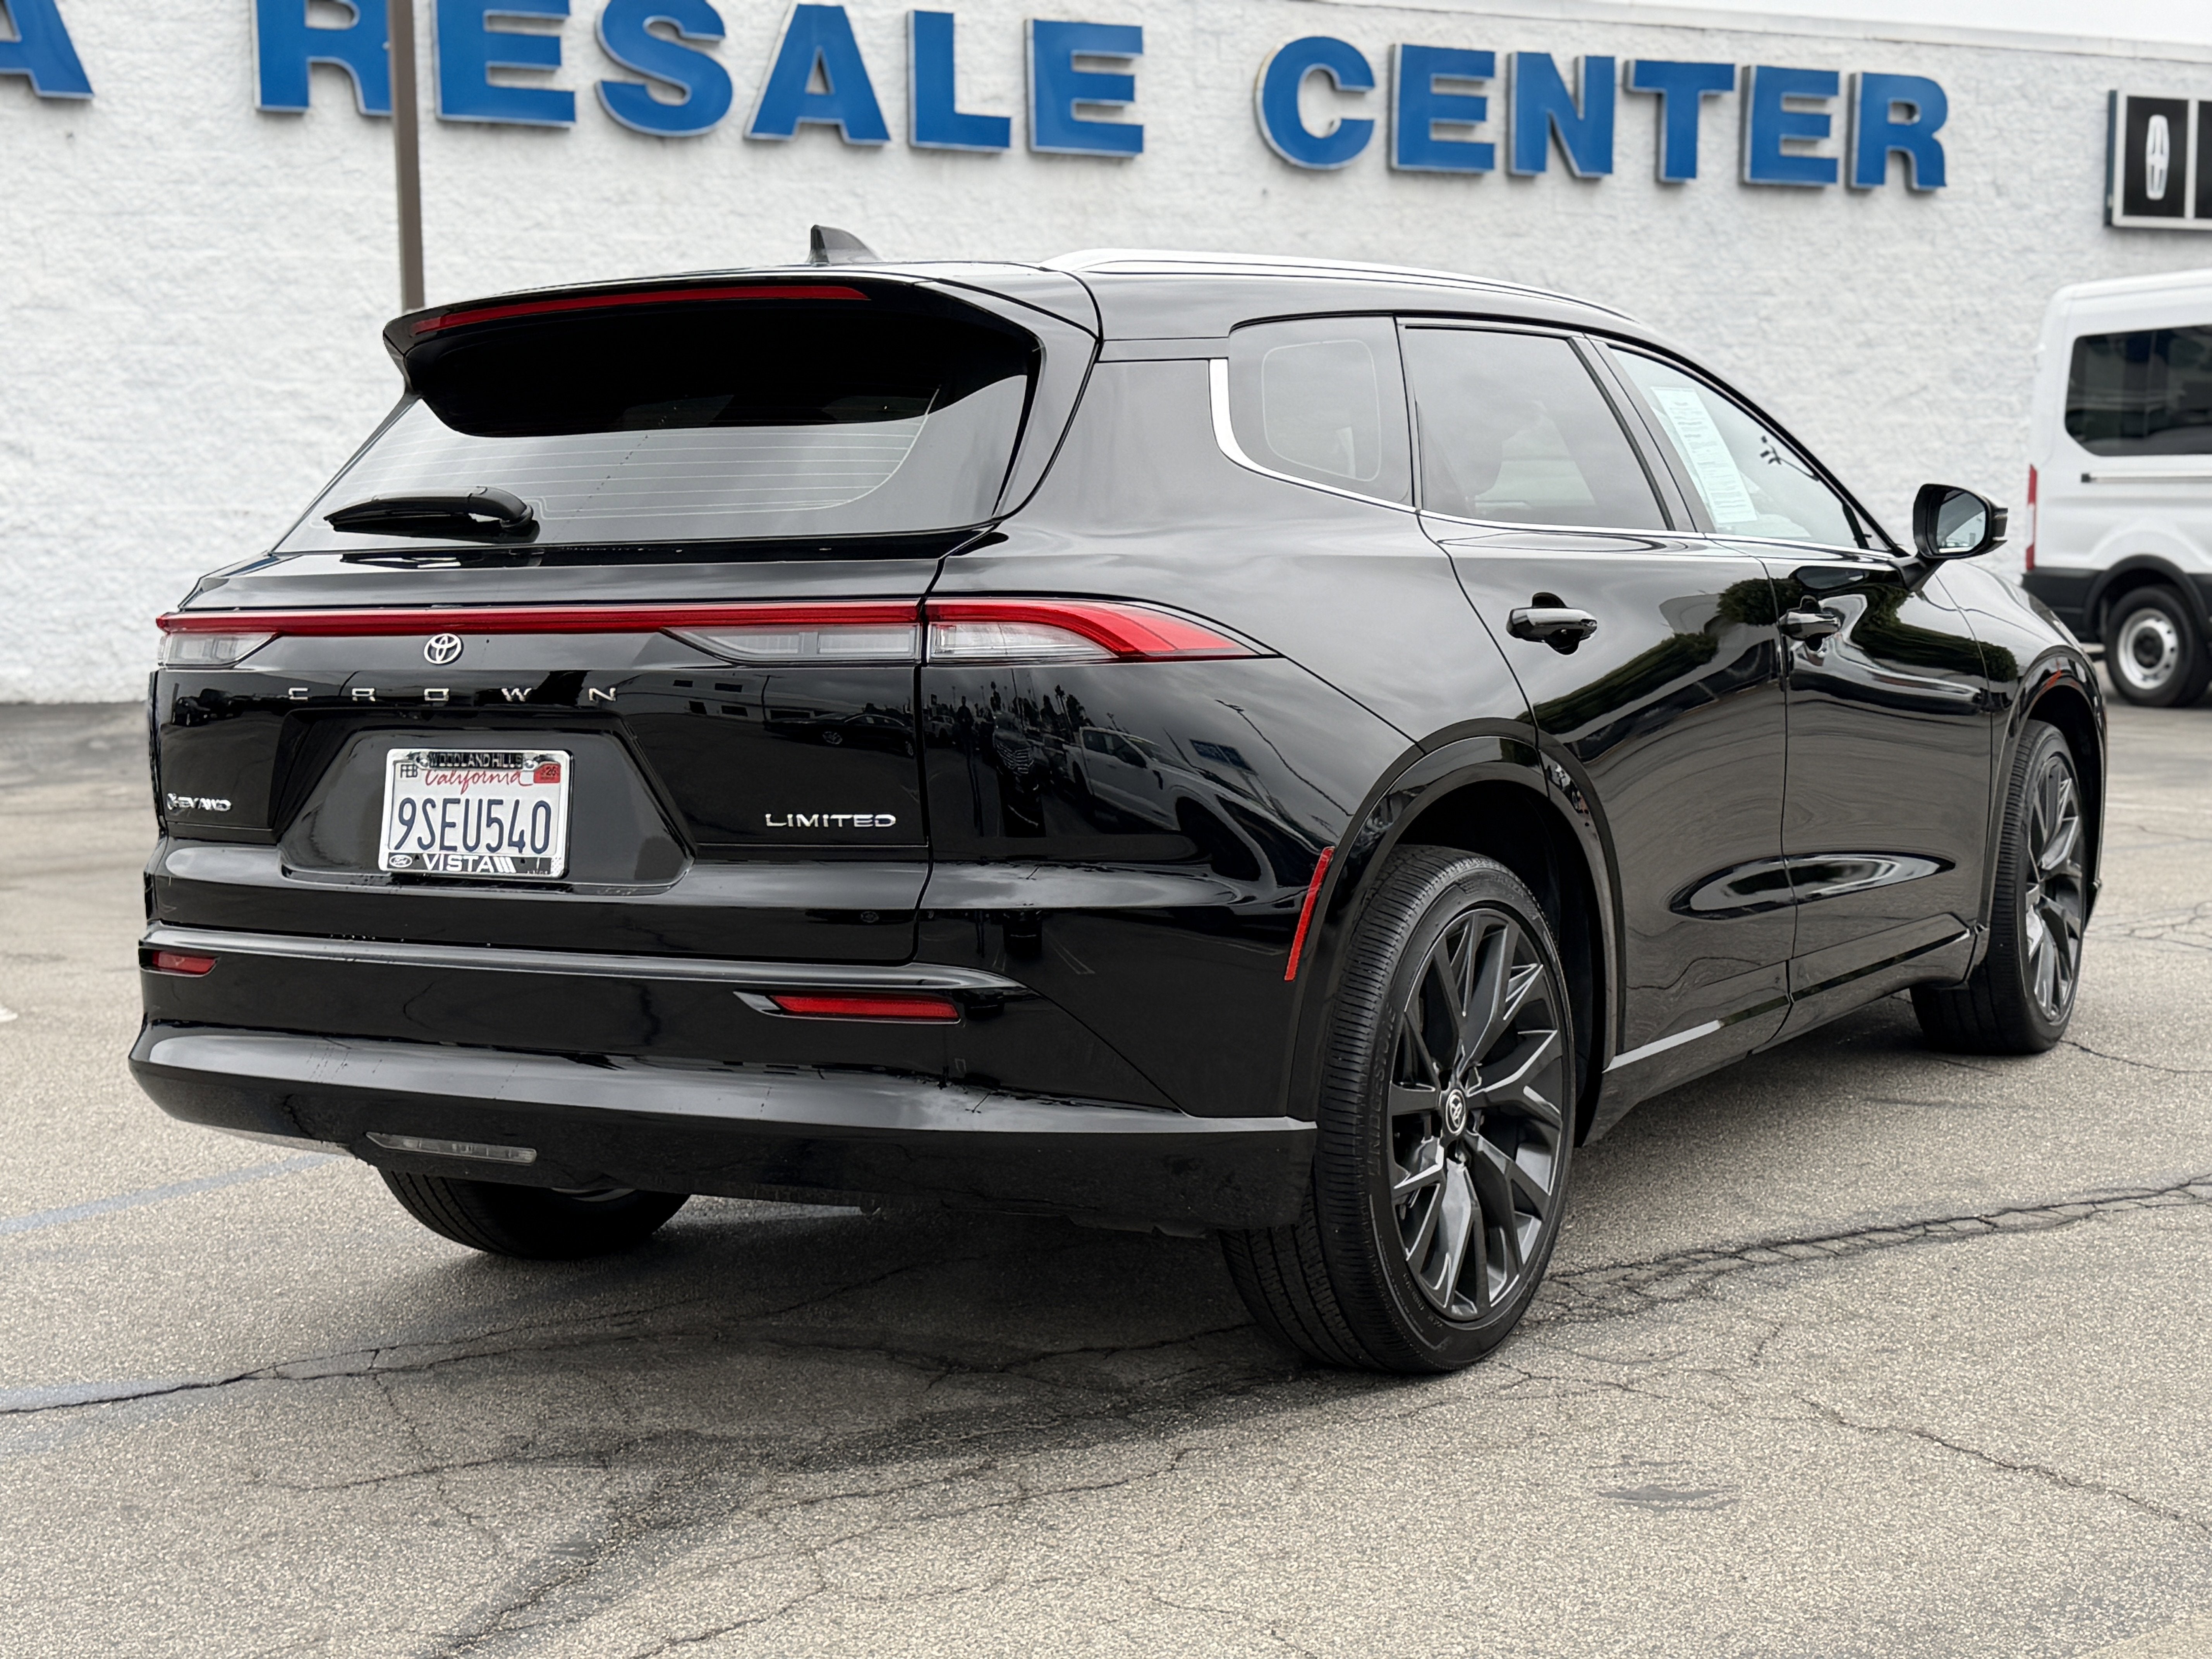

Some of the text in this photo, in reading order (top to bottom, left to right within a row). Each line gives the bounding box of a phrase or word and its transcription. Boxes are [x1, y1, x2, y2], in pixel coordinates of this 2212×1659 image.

[252, 0, 1144, 158] RESALE
[1254, 35, 1949, 191] CENTER
[289, 687, 616, 702] CROWN
[429, 753, 522, 768] WOODLAND HILLS
[400, 764, 418, 778] FEB
[425, 769, 533, 795] California
[393, 797, 551, 854] 9SEU540
[765, 814, 896, 827] LIMITED
[422, 853, 495, 872] VISTA
